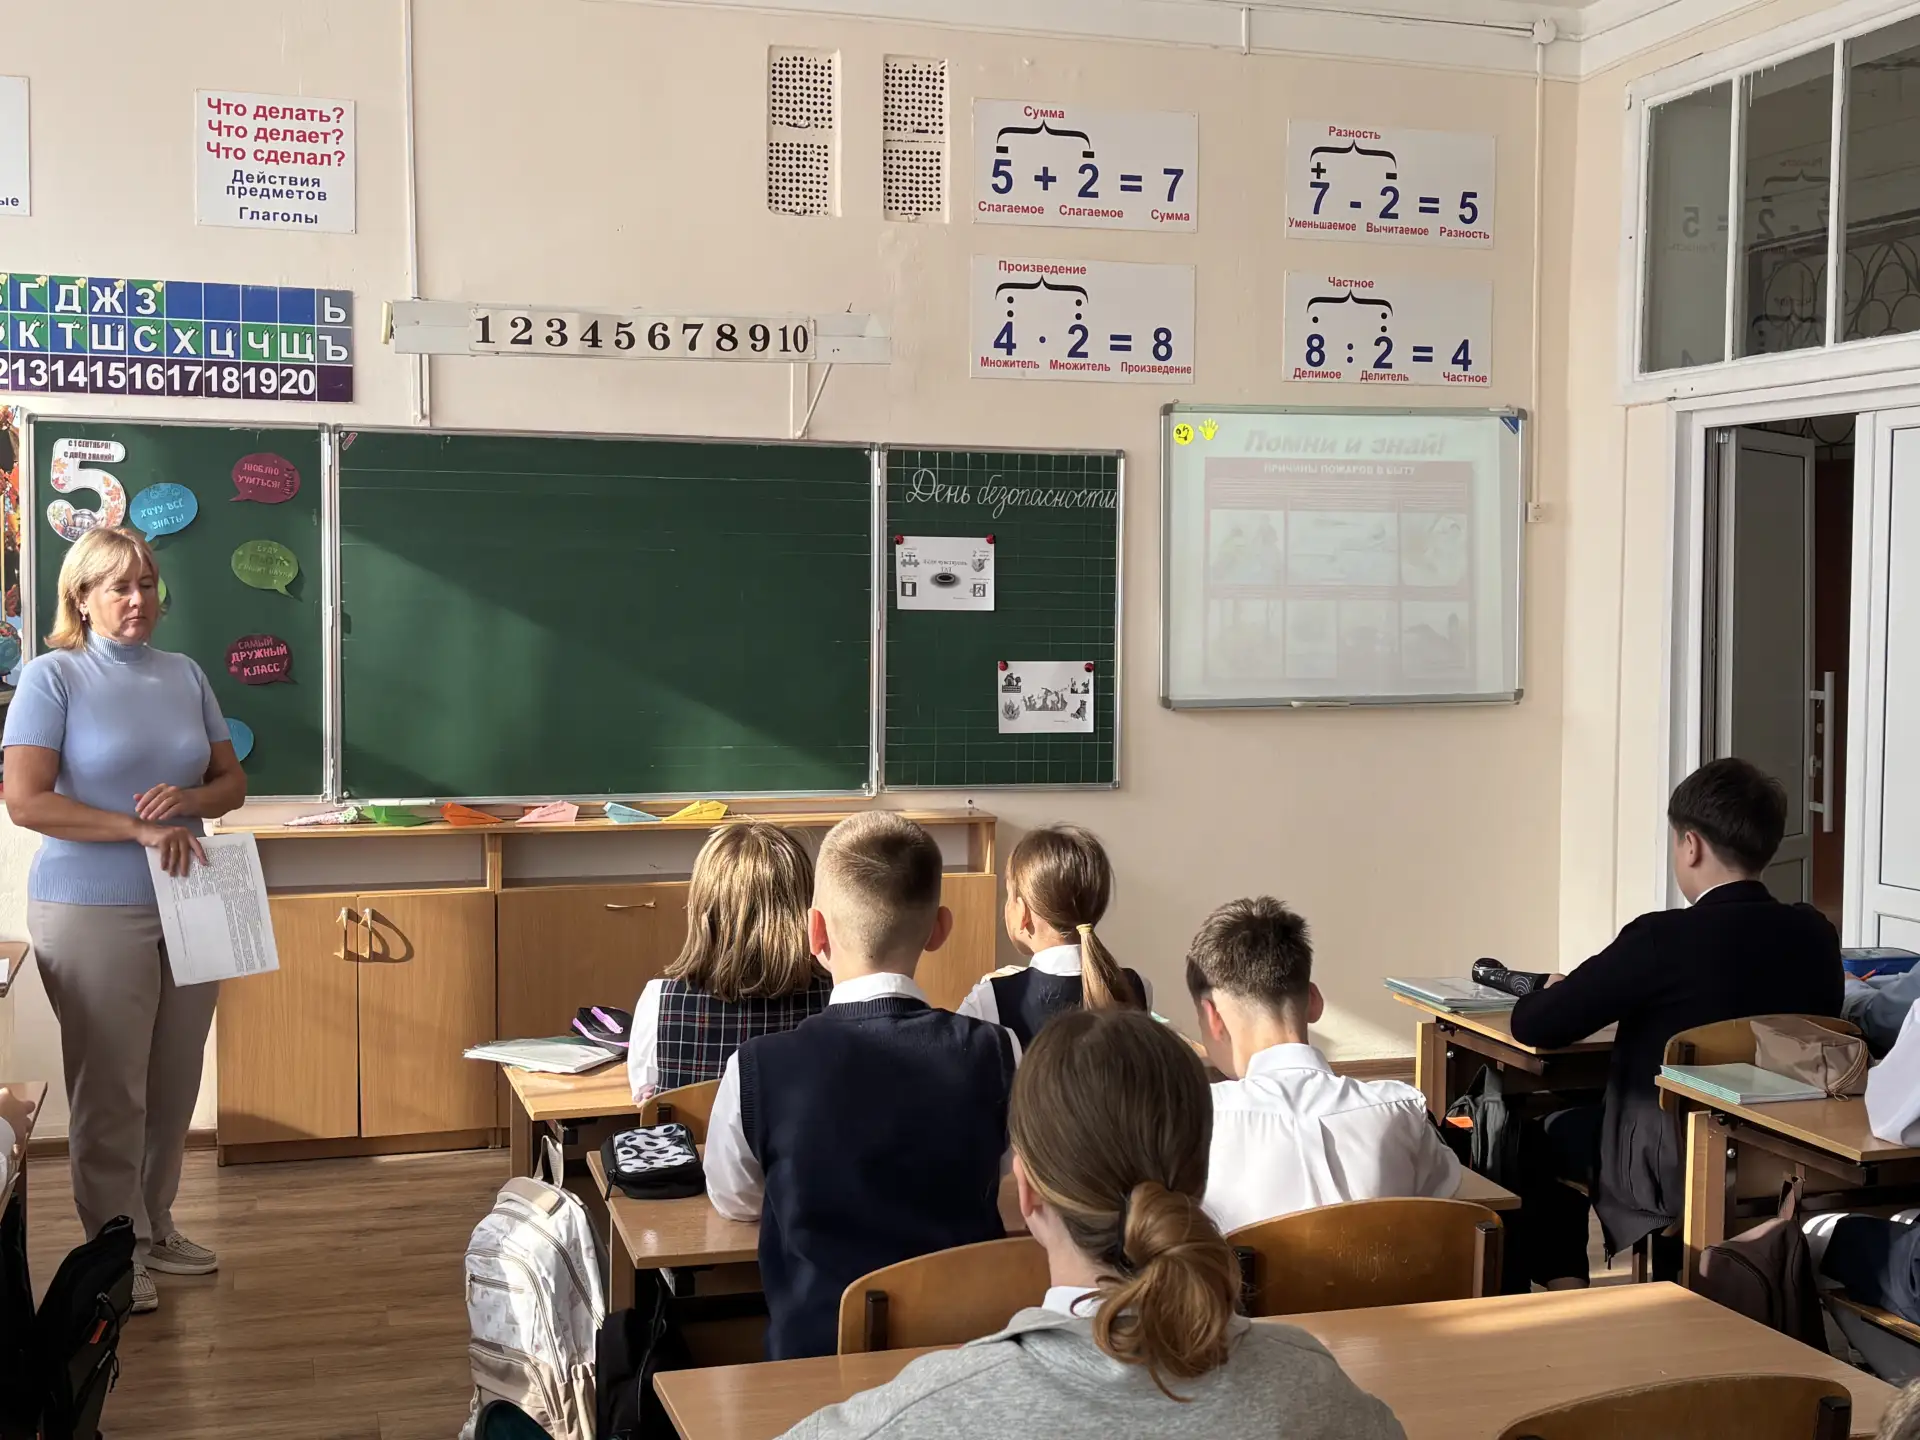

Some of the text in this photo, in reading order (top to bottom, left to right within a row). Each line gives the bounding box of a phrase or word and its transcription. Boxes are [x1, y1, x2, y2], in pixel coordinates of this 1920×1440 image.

[207, 98, 345, 124] Что делать?
[1024, 106, 1065, 120] Сумма
[208, 120, 344, 145] Что делает?
[1328, 126, 1381, 140] Разность
[206, 142, 346, 166] Что сделал?
[232, 170, 320, 187] Действия
[992, 158, 1013, 194] 5
[1078, 163, 1099, 198] 2
[1163, 168, 1184, 202] 7
[226, 185, 327, 201] предметов
[1310, 182, 1330, 214] 7
[1379, 186, 1400, 220] 2
[1458, 192, 1478, 224] 5
[239, 207, 318, 224] Глаголы
[978, 201, 1190, 222] Слагаемое Слагаемое Сумма
[1288, 217, 1490, 240] Уменьшаемое Вычитаемое Разность
[998, 260, 1086, 276] Произведение
[1328, 276, 1374, 288] Частное
[20, 282, 39, 309] Г
[55, 285, 81, 313] Д
[91, 286, 124, 313] Ж
[324, 297, 346, 323] Ь
[20, 320, 348, 361] К Т Ш С Х Ц Ч Щ Ъ
[476, 315, 808, 353] 1 2 3 4 5 6 7 8 9 10
[994, 322, 1016, 356] 4
[1067, 324, 1088, 358] 2
[1152, 327, 1172, 362] 8
[1306, 334, 1326, 368] 8
[1372, 336, 1394, 369] 2
[1452, 339, 1472, 372] 4
[12, 358, 48, 386] 13
[51, 360, 87, 387] 14
[90, 362, 126, 388] 15
[129, 363, 164, 390] 16
[168, 364, 202, 391] 17
[206, 366, 240, 392] 18
[244, 367, 277, 394] 19
[280, 368, 315, 395] 20
[980, 356, 1192, 375] Множитель Множитель Произведение
[1293, 368, 1488, 384] Делимое Делитель Частное
[1244, 430, 1338, 454] Помни
[1371, 432, 1448, 456] знай!
[906, 468, 1116, 519] День безопасности
[231, 644, 288, 664] ДРУЖНЫЙ
[238, 636, 273, 650] САМЫЙ
[244, 663, 280, 676] КЛАСС
